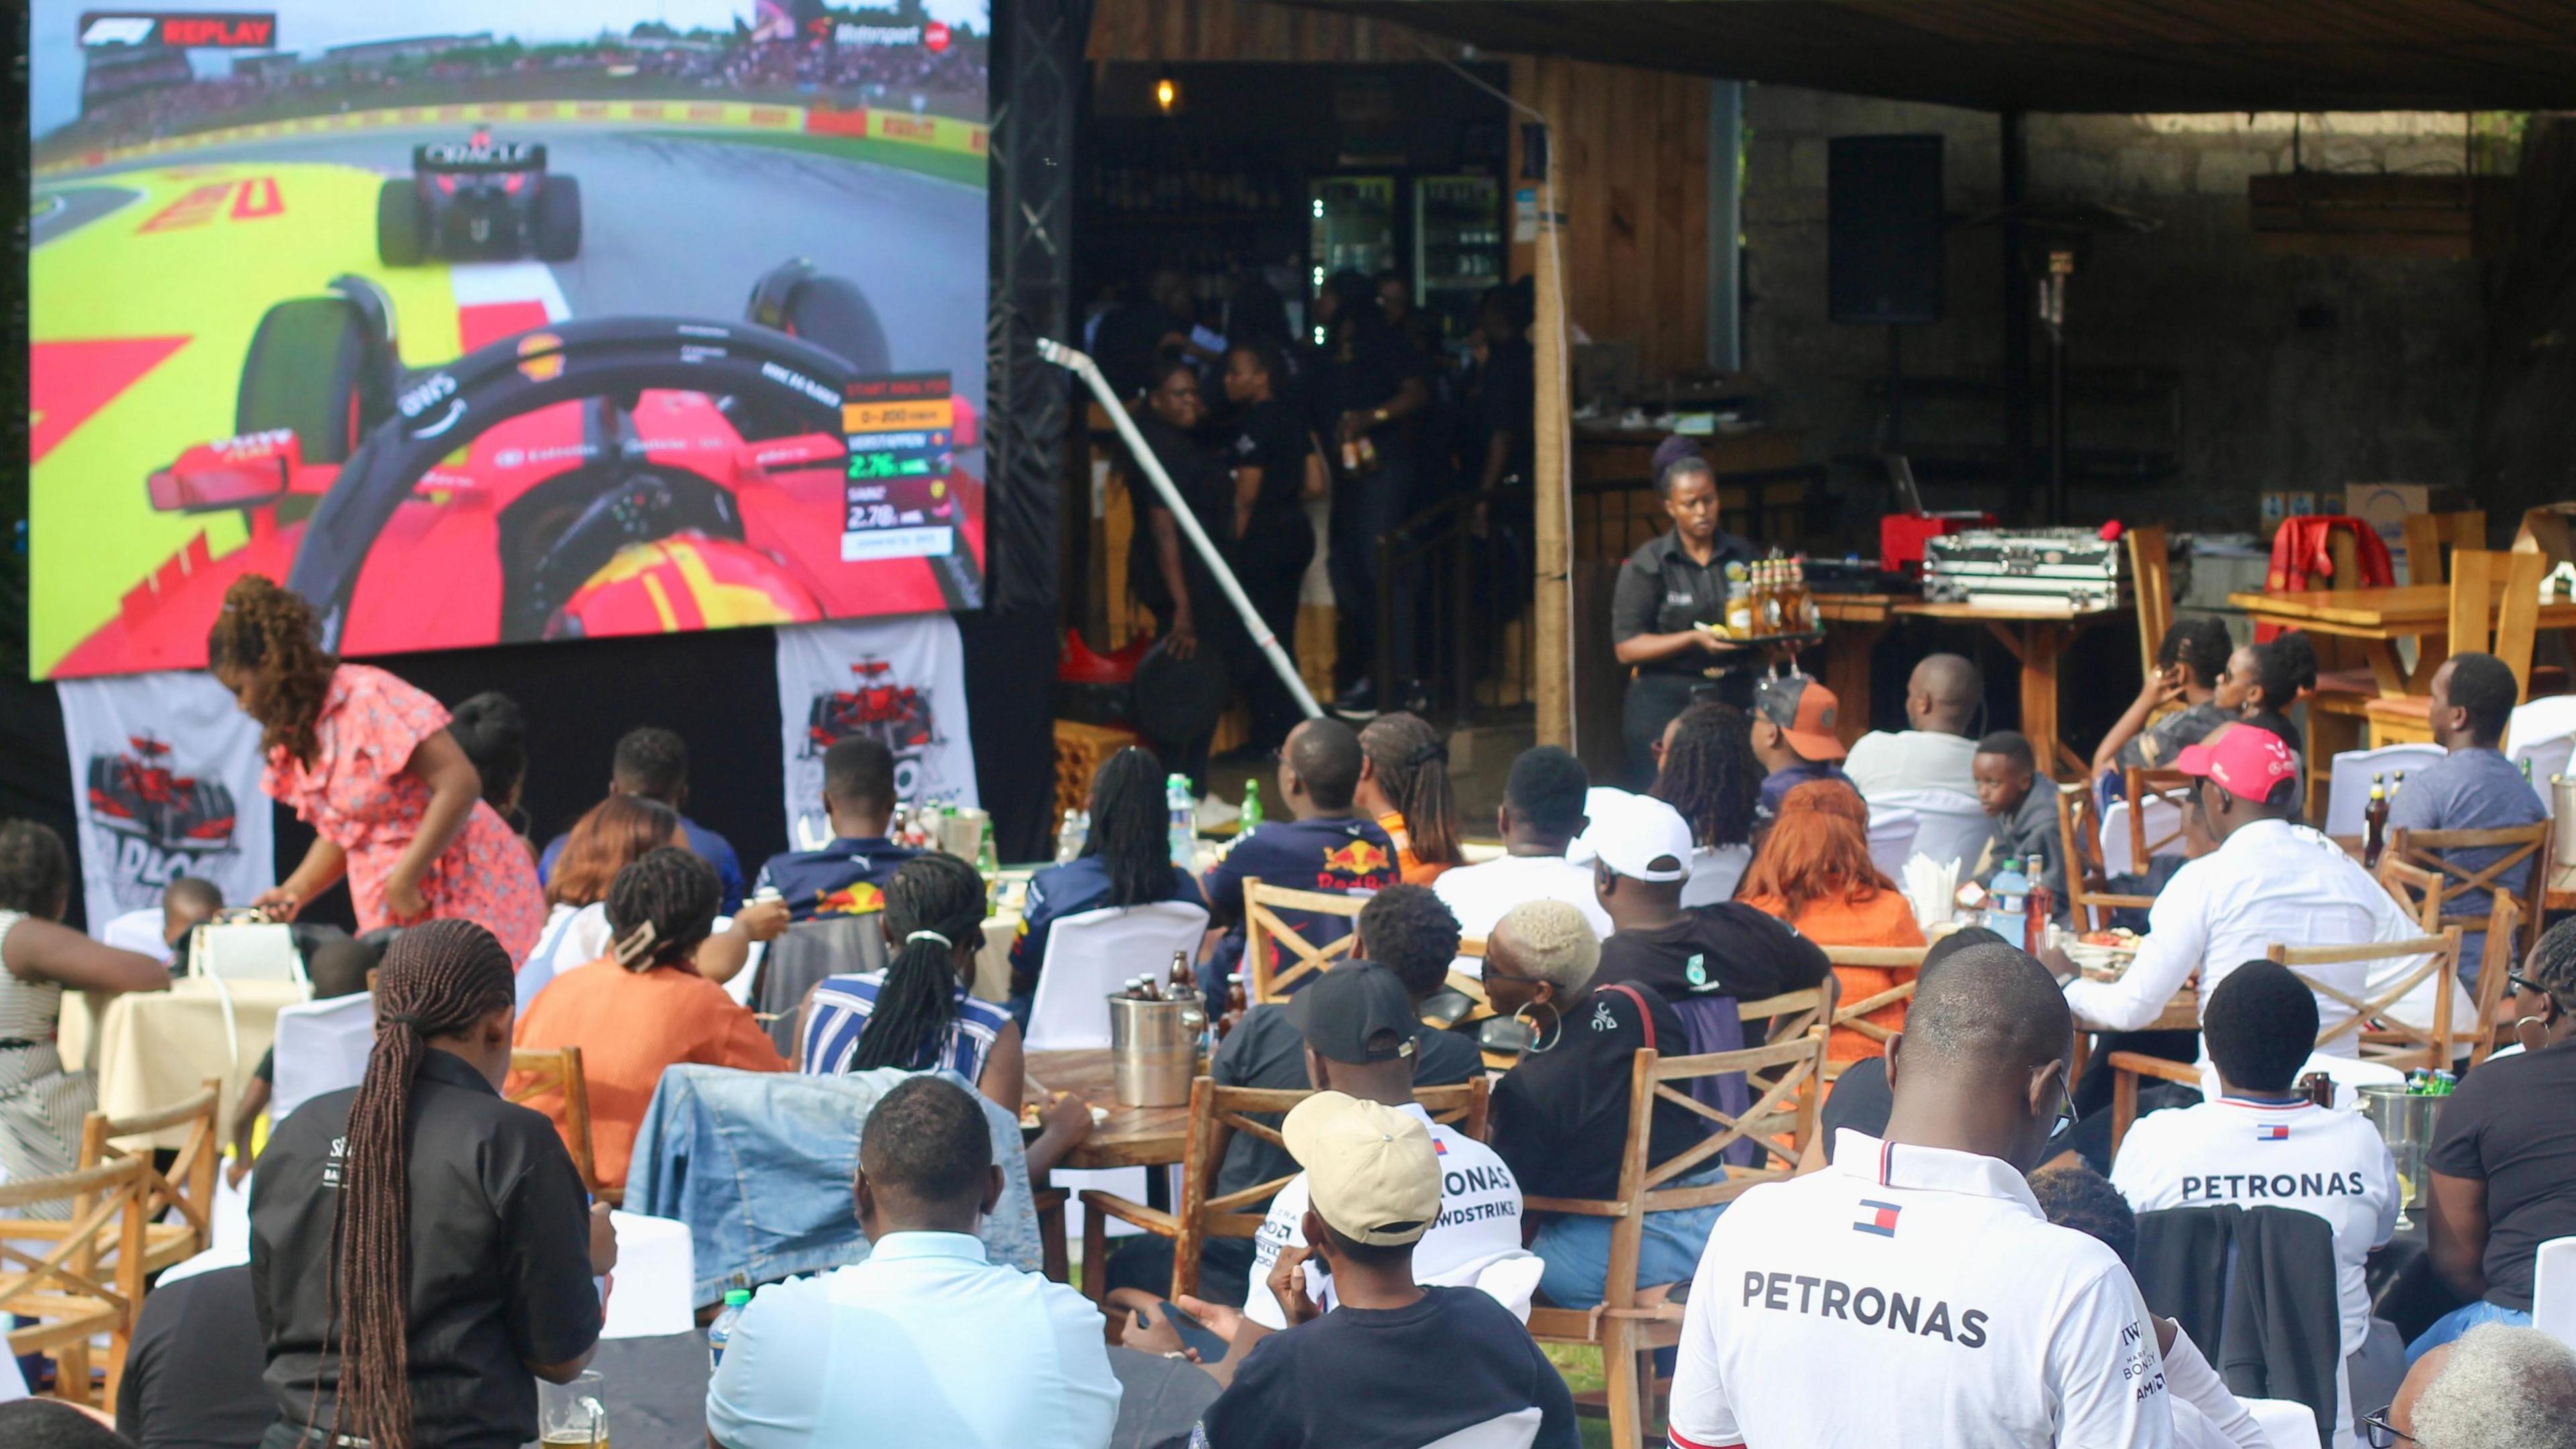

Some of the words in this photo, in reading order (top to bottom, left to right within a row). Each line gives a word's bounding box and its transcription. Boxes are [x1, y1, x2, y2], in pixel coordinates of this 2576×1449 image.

[162, 20, 272, 46] REPLAY
[835, 23, 920, 47] Motorsport
[1441, 1166, 1510, 1199] ONAS
[2182, 1171, 2365, 1199] PETRONAS
[1743, 1271, 1989, 1349] PETRONAS
